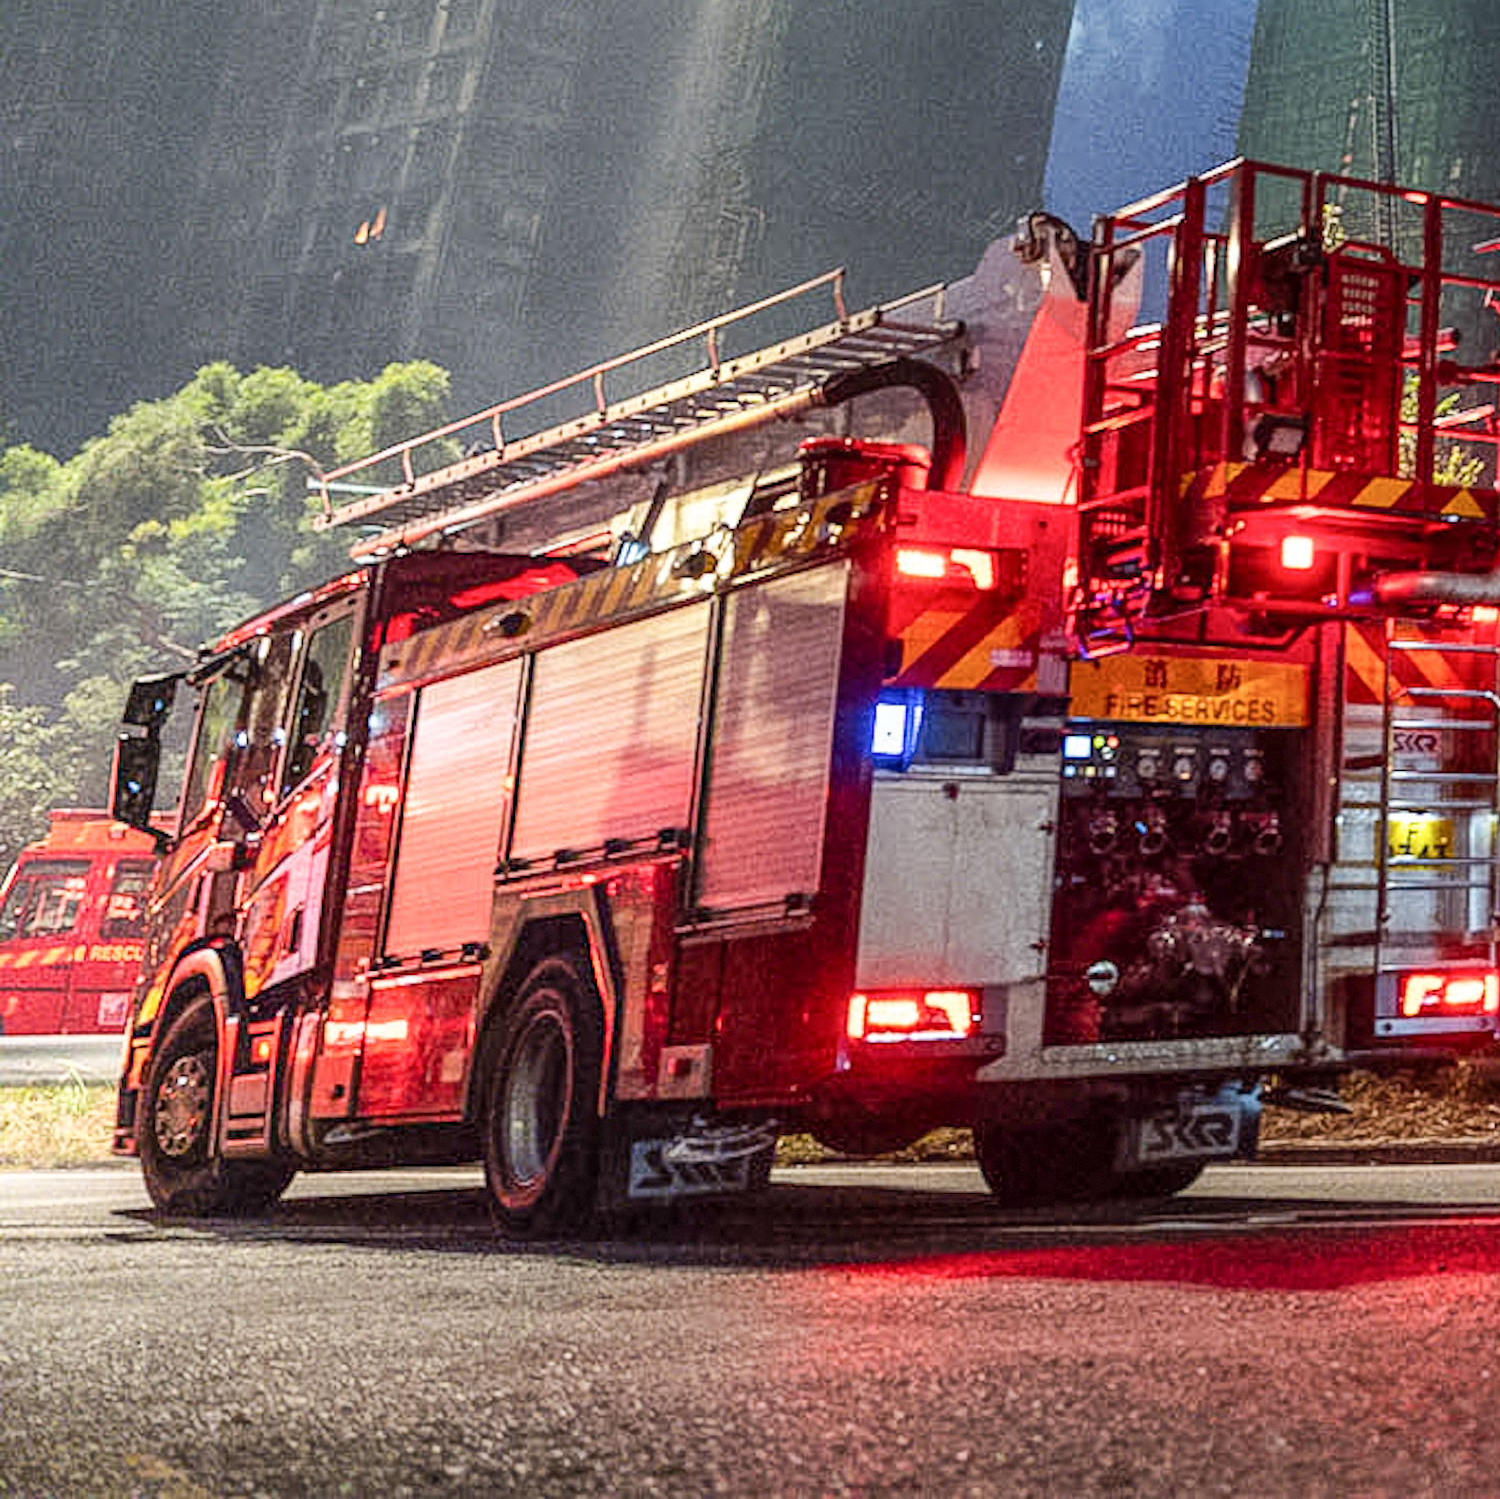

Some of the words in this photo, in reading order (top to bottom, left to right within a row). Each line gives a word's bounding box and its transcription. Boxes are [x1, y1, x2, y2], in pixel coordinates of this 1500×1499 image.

[1106, 694, 1158, 717] FIRE
[1165, 699, 1276, 722] SERVICES
[90, 944, 144, 962] RESCU
